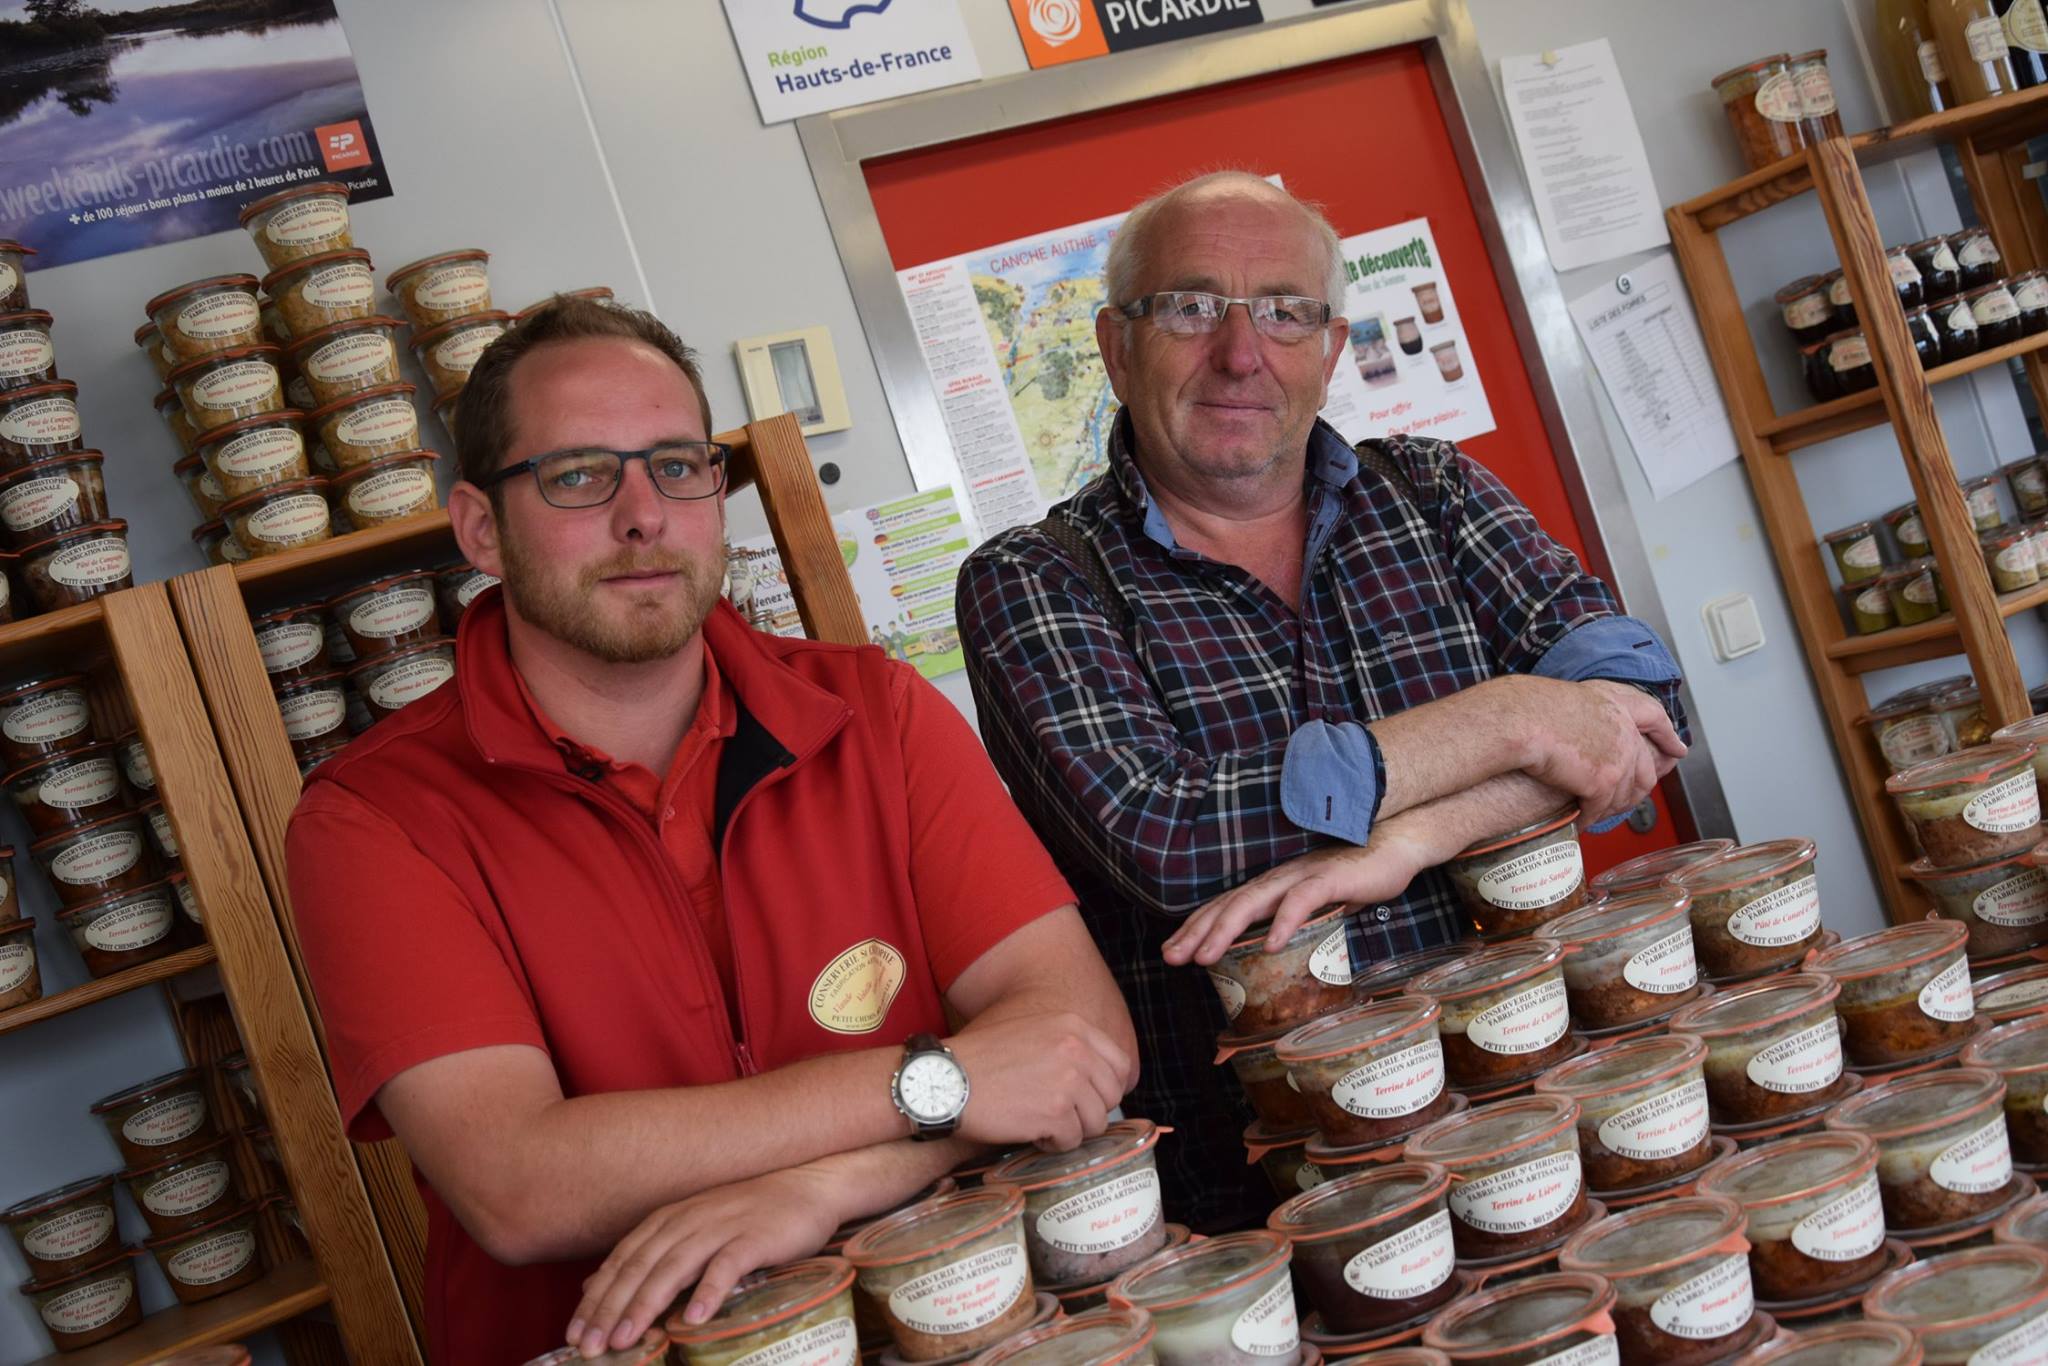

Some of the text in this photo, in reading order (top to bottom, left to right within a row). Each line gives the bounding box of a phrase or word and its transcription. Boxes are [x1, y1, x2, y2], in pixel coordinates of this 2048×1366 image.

[768, 45, 828, 67] Région
[775, 45, 952, 94] Hauts-de-France
[82, 211, 96, 223] de
[95, 207, 113, 220] 100
[115, 200, 148, 218] séjours
[150, 195, 172, 210] bons
[173, 191, 197, 208] plans
[206, 184, 234, 198] moins
[235, 179, 247, 192] de
[248, 178, 254, 190] 2
[254, 175, 285, 189] heures
[285, 171, 296, 182] de
[297, 166, 320, 179] Paris
[990, 235, 1097, 274] CANCHE AUTHIE
[1359, 237, 1431, 277] découverte
[1370, 410, 1389, 420] Pour
[1483, 855, 1536, 882] CONSERVERIE
[1494, 863, 1543, 884] FABRICATION
[1510, 881, 1537, 893] Terrine
[1491, 897, 1513, 907] PETIT
[1514, 898, 1545, 908] CHEMIN
[1736, 886, 1792, 918] CONSERVERIE
[1748, 894, 1795, 920] FABRICATION
[1755, 920, 1772, 930] Pâté
[1743, 934, 1797, 944] PETIT CHEMIN
[815, 952, 860, 1008] CONSERVERIE
[1475, 993, 1532, 1025] CONSERVERIE
[1487, 1000, 1538, 1027] FABRICATION
[1502, 1021, 1531, 1036] Terrine
[1483, 1040, 1540, 1052] PETIT CHEMIN
[1756, 1031, 1814, 1063] CONSERVERIE
[1769, 1039, 1818, 1065] FABRICATION
[1337, 1040, 1440, 1087] CONSERVERIE CHRISTOPH
[1351, 1064, 1405, 1090] FABRICATION
[1375, 1083, 1404, 1096] Terrine
[1406, 1077, 1414, 1086] de
[1763, 1080, 1787, 1091] PETIT
[1345, 1102, 1369, 1114] PETIT
[1371, 1105, 1406, 1116] CHEMIN
[1607, 1096, 1670, 1128] CONSERVERIE
[1620, 1104, 1675, 1132] FABRICATION
[1636, 1126, 1667, 1141] Terrine
[1615, 1144, 1677, 1158] PETIT CHEMIN
[1454, 1152, 1574, 1197] CONSERVERIE CHRISTOPHE
[1467, 1163, 1570, 1202] FABRICATION ARTISANALE
[1042, 1188, 1106, 1221] CONSERVERIE
[1055, 1196, 1112, 1224] FABRICATION
[1491, 1199, 1523, 1212] Terrine
[1526, 1193, 1536, 1202] de
[1463, 1214, 1489, 1228] PETIT
[1489, 1220, 1527, 1231] CHEMIN
[1053, 1239, 1078, 1252] PETIT
[1080, 1240, 1116, 1252] CHEMIN
[1353, 1230, 1418, 1266] CONSERVERIE
[1368, 1238, 1423, 1269] FABRICATION
[894, 1267, 956, 1300] CONSERVERIE
[906, 1257, 1014, 1302] FABRICATION ARTISANALE
[1362, 1284, 1426, 1298] PETIT CHEMIN
[906, 1317, 931, 1331] PETIT
[932, 1321, 969, 1332] CHEMIN
